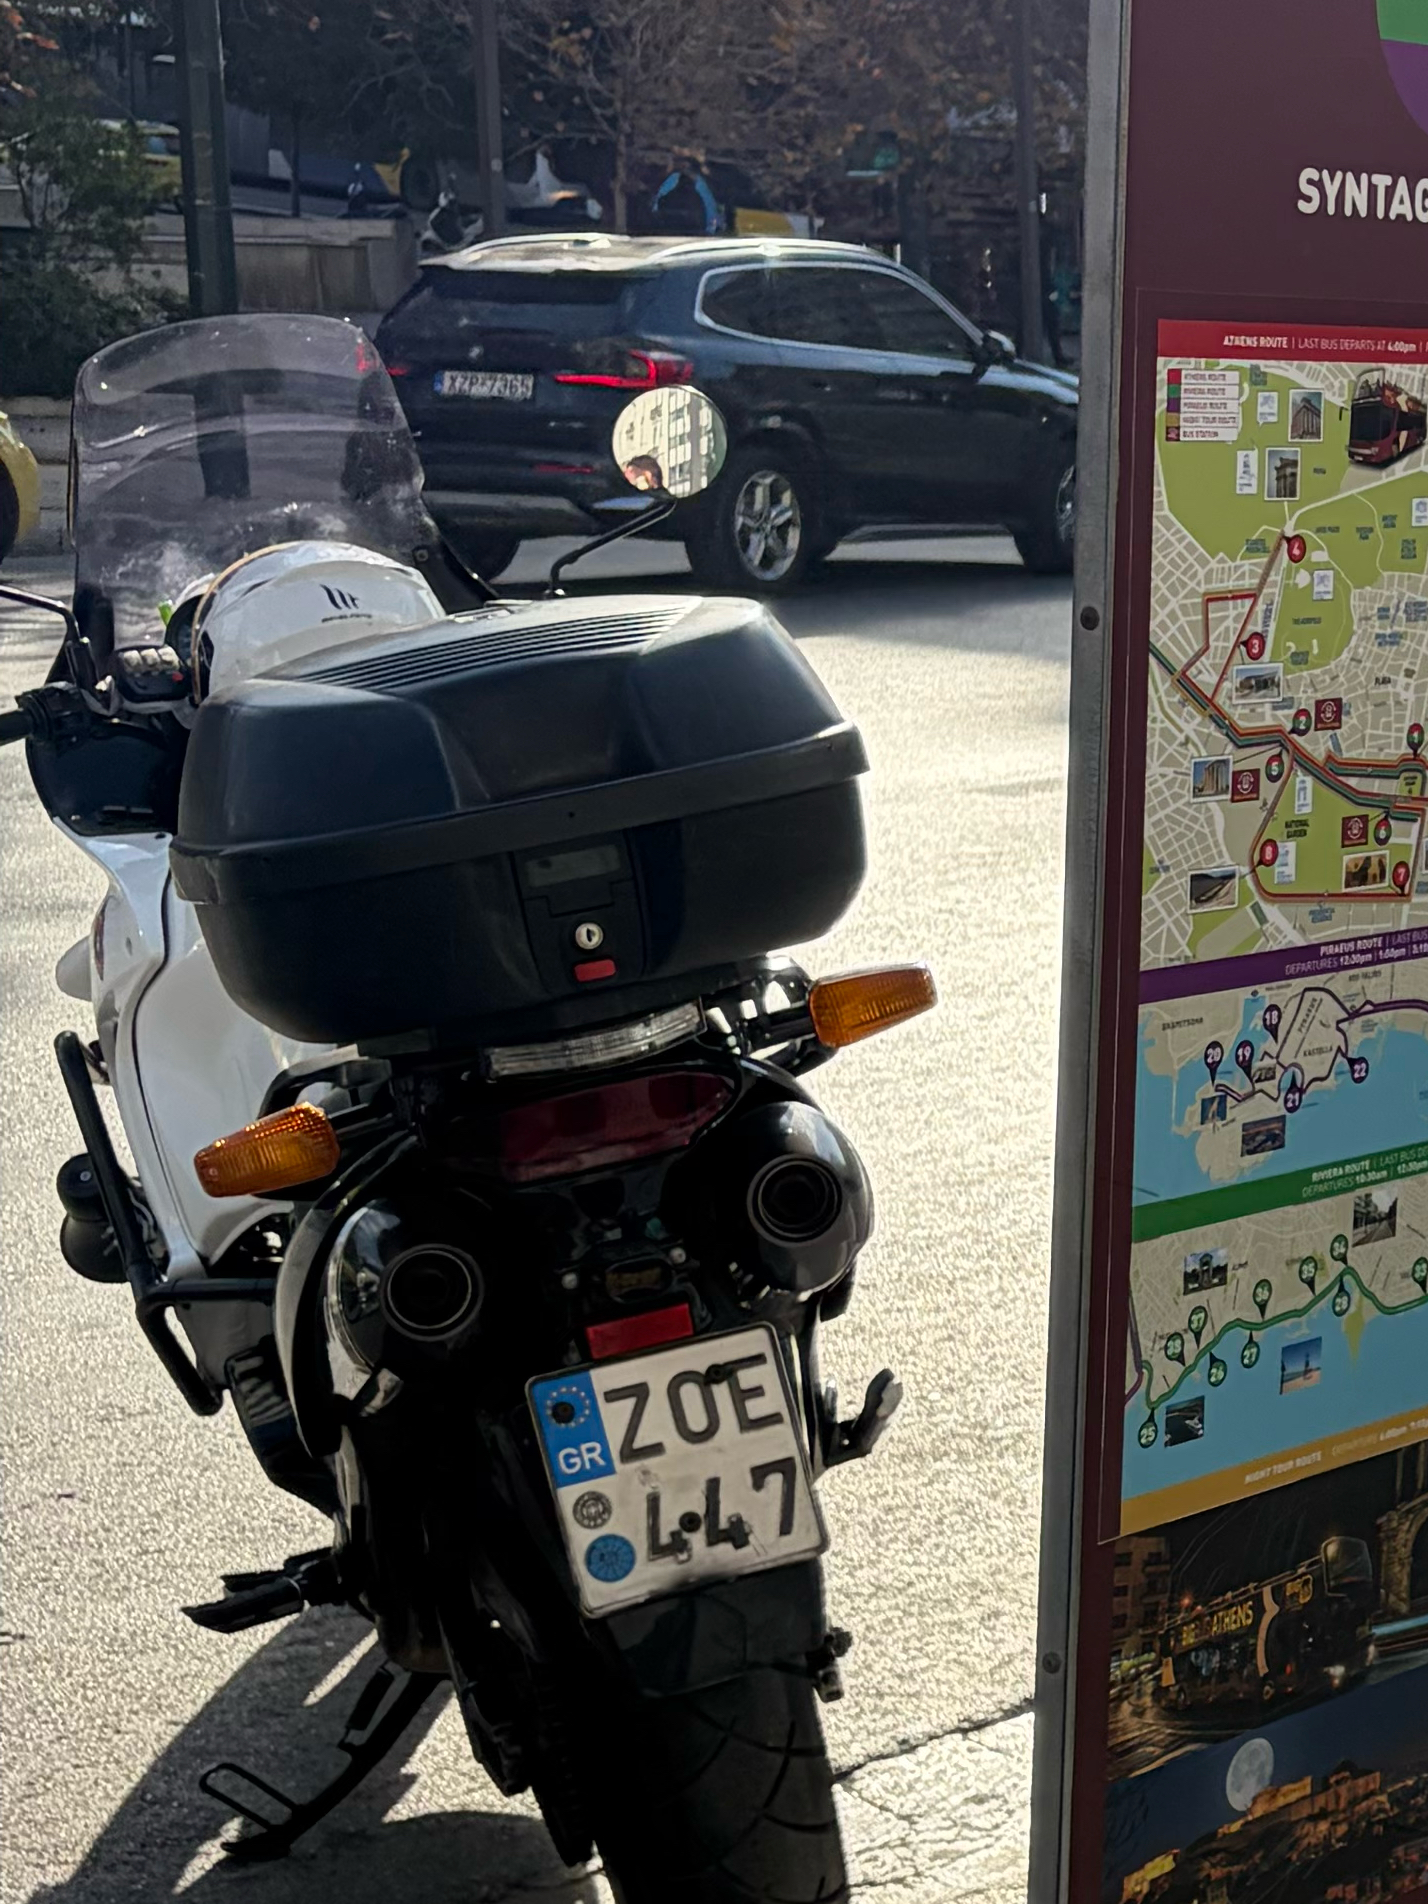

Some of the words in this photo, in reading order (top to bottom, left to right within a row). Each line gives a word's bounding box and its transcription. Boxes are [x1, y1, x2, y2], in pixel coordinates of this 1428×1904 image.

[1260, 336, 1288, 349] ROUTE
[1298, 336, 1320, 349] LAST
[1320, 337, 1338, 350] BUS
[1252, 640, 1259, 653] 3
[1271, 762, 1279, 775] 5
[1397, 867, 1404, 881] 7
[1320, 941, 1354, 956] PIRAEUS
[1356, 937, 1383, 951] ROUTE
[1392, 933, 1410, 945] LAST
[1285, 957, 1338, 975] DEPARTURES
[1340, 952, 1373, 968] 12:30pm
[1264, 1011, 1279, 1025] 18
[1206, 1048, 1221, 1063] 20
[1237, 1048, 1251, 1062] 19
[1354, 1062, 1367, 1077] 22
[1286, 1093, 1300, 1107] 21
[1312, 1167, 1343, 1182] RIVIERA
[1345, 1159, 1371, 1175] ROUTE
[1380, 1153, 1398, 1166] LAST
[1302, 1178, 1354, 1198] DEPARTURES
[1242, 1348, 1257, 1364] 27
[603, 1352, 785, 1465] ZOE
[1140, 1426, 1156, 1443] 25
[558, 1440, 606, 1475] GR
[1295, 1450, 1323, 1468] ROUTE
[645, 1455, 797, 1563] 447
[1211, 1601, 1254, 1637] ATHENS
